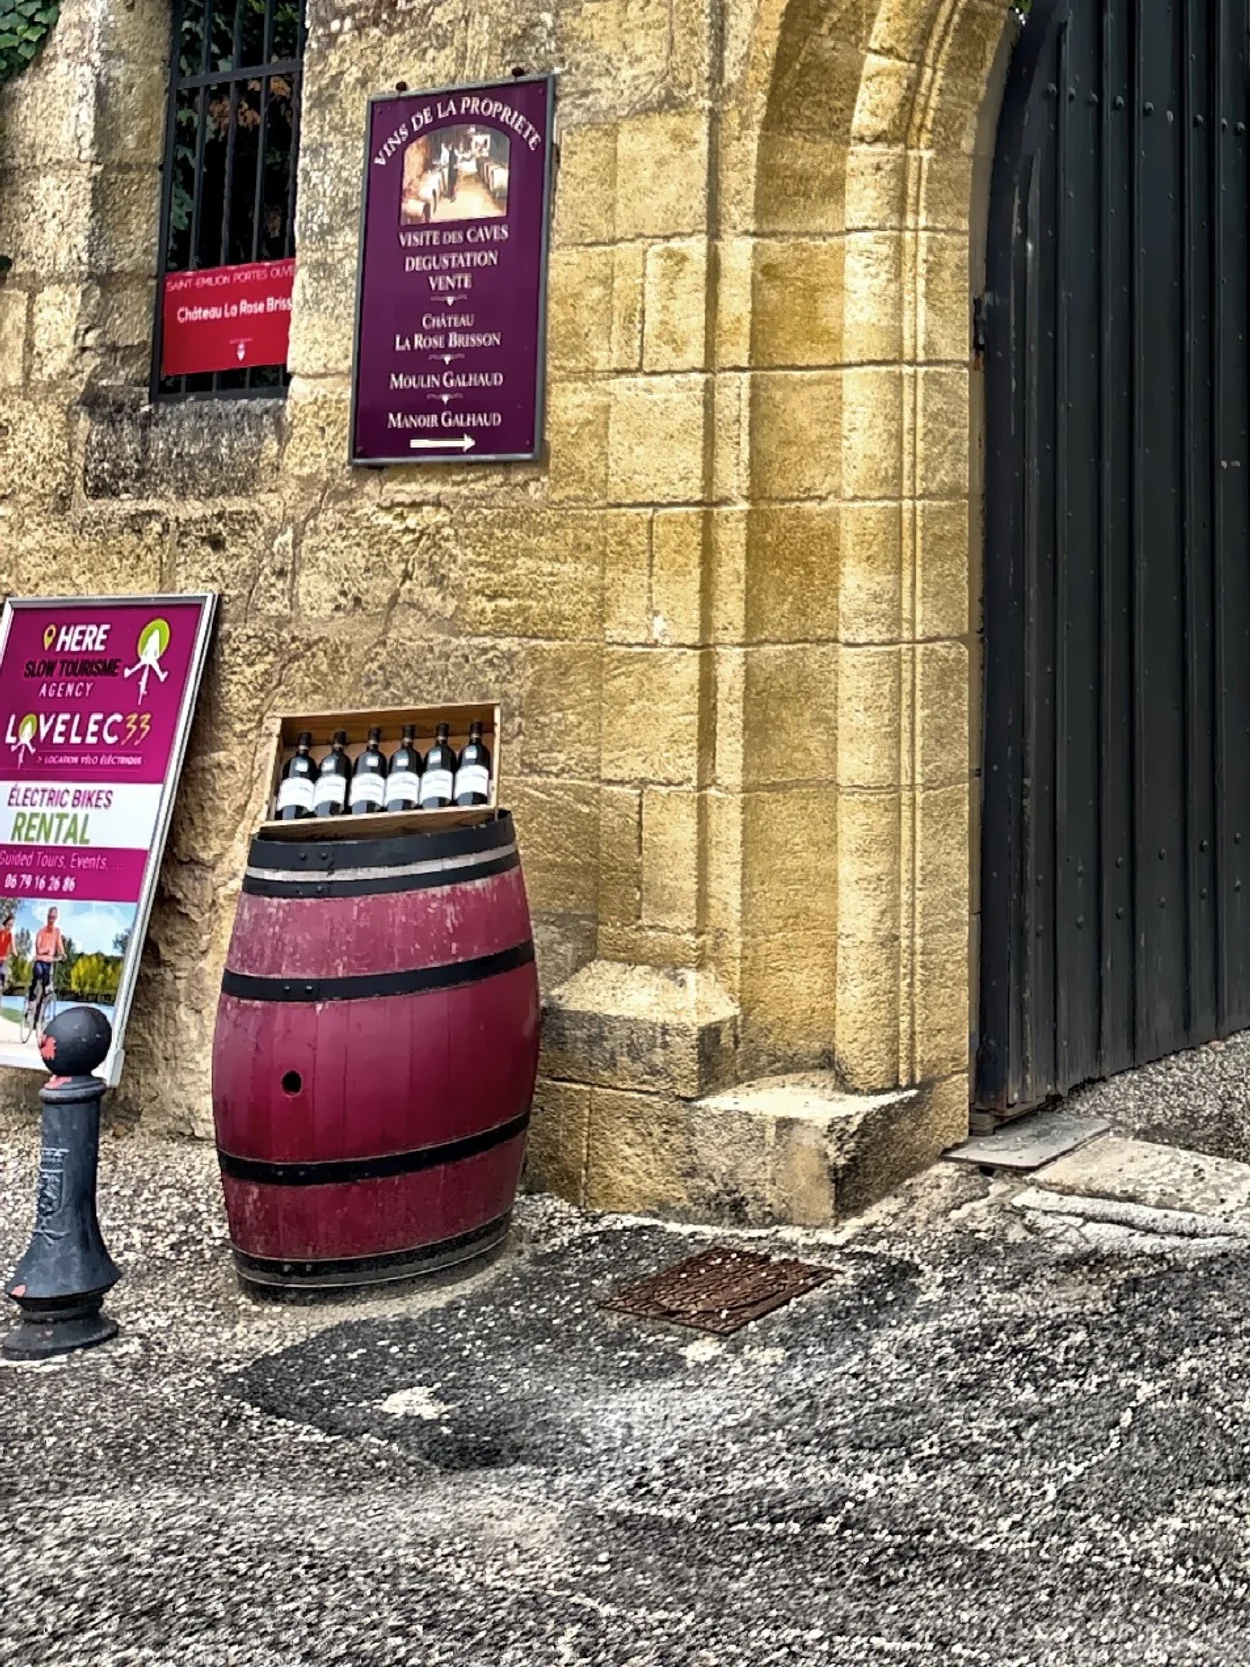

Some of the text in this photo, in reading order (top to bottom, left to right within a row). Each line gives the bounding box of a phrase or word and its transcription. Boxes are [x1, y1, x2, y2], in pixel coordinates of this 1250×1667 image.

[374, 96, 542, 166] VINS DE LA PROPRIETE
[399, 224, 509, 248] VISITE DES CAVES
[405, 250, 499, 272] DEGUSTATION
[233, 269, 268, 284] PORTES
[428, 273, 472, 291] VENTE
[224, 302, 238, 318] La
[240, 299, 264, 315] Rose
[414, 333, 446, 350] ROSE
[448, 331, 502, 348] BRISSON
[389, 370, 504, 390] MOULIN GALHAUD
[387, 410, 502, 429] MANOIR GALHAUD
[55, 623, 111, 652] HERE
[24, 658, 122, 678] SLOW TOURISME
[39, 682, 94, 698] AGENCY
[7, 784, 114, 809] ÉLECTRIC BIKES
[10, 811, 91, 845] RENTAL
[4, 873, 17, 889] 06
[19, 873, 33, 889] 79
[34, 875, 46, 891] 16
[47, 876, 61, 892] 26
